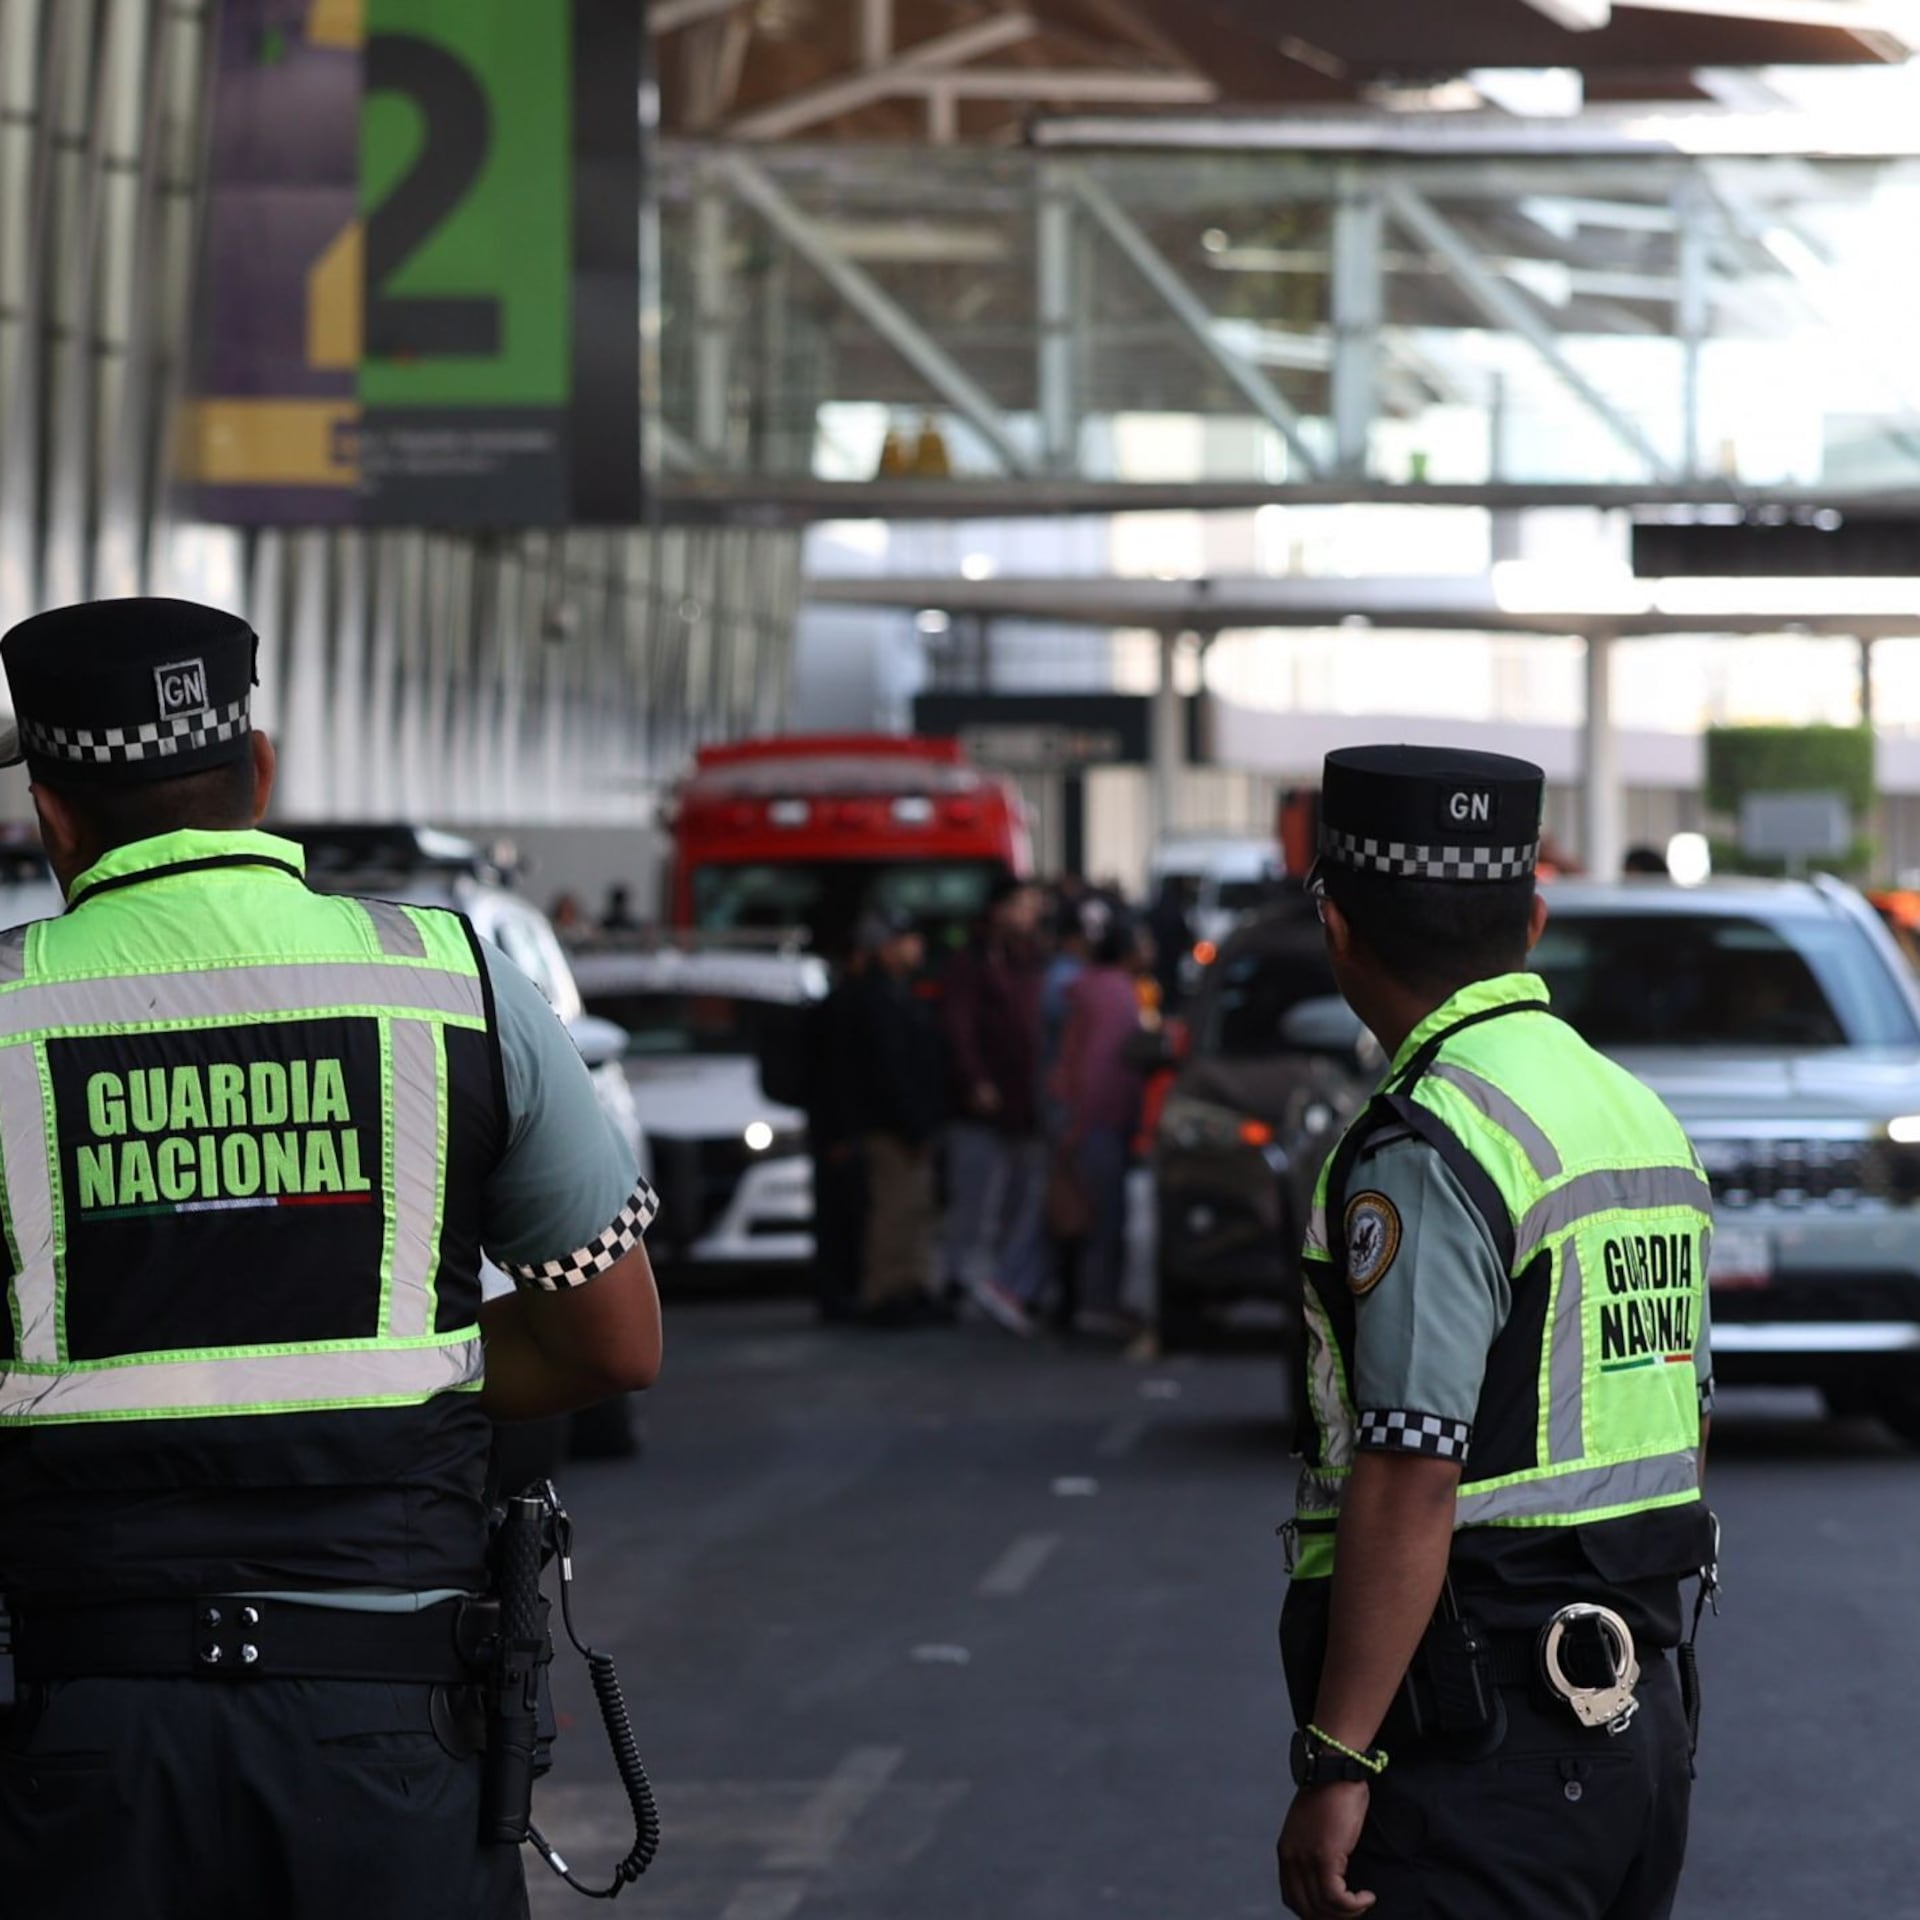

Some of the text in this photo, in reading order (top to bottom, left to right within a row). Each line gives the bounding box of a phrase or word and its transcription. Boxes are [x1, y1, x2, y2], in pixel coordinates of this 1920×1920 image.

[310, 26, 503, 367] 2
[164, 670, 202, 707] GN
[1449, 791, 1490, 821] GN
[87, 1058, 350, 1137] GUARDIA
[76, 1128, 371, 1208] NACIONAL
[1603, 1233, 1691, 1295] GURDIA
[1600, 1295, 1692, 1360] NAONAL
